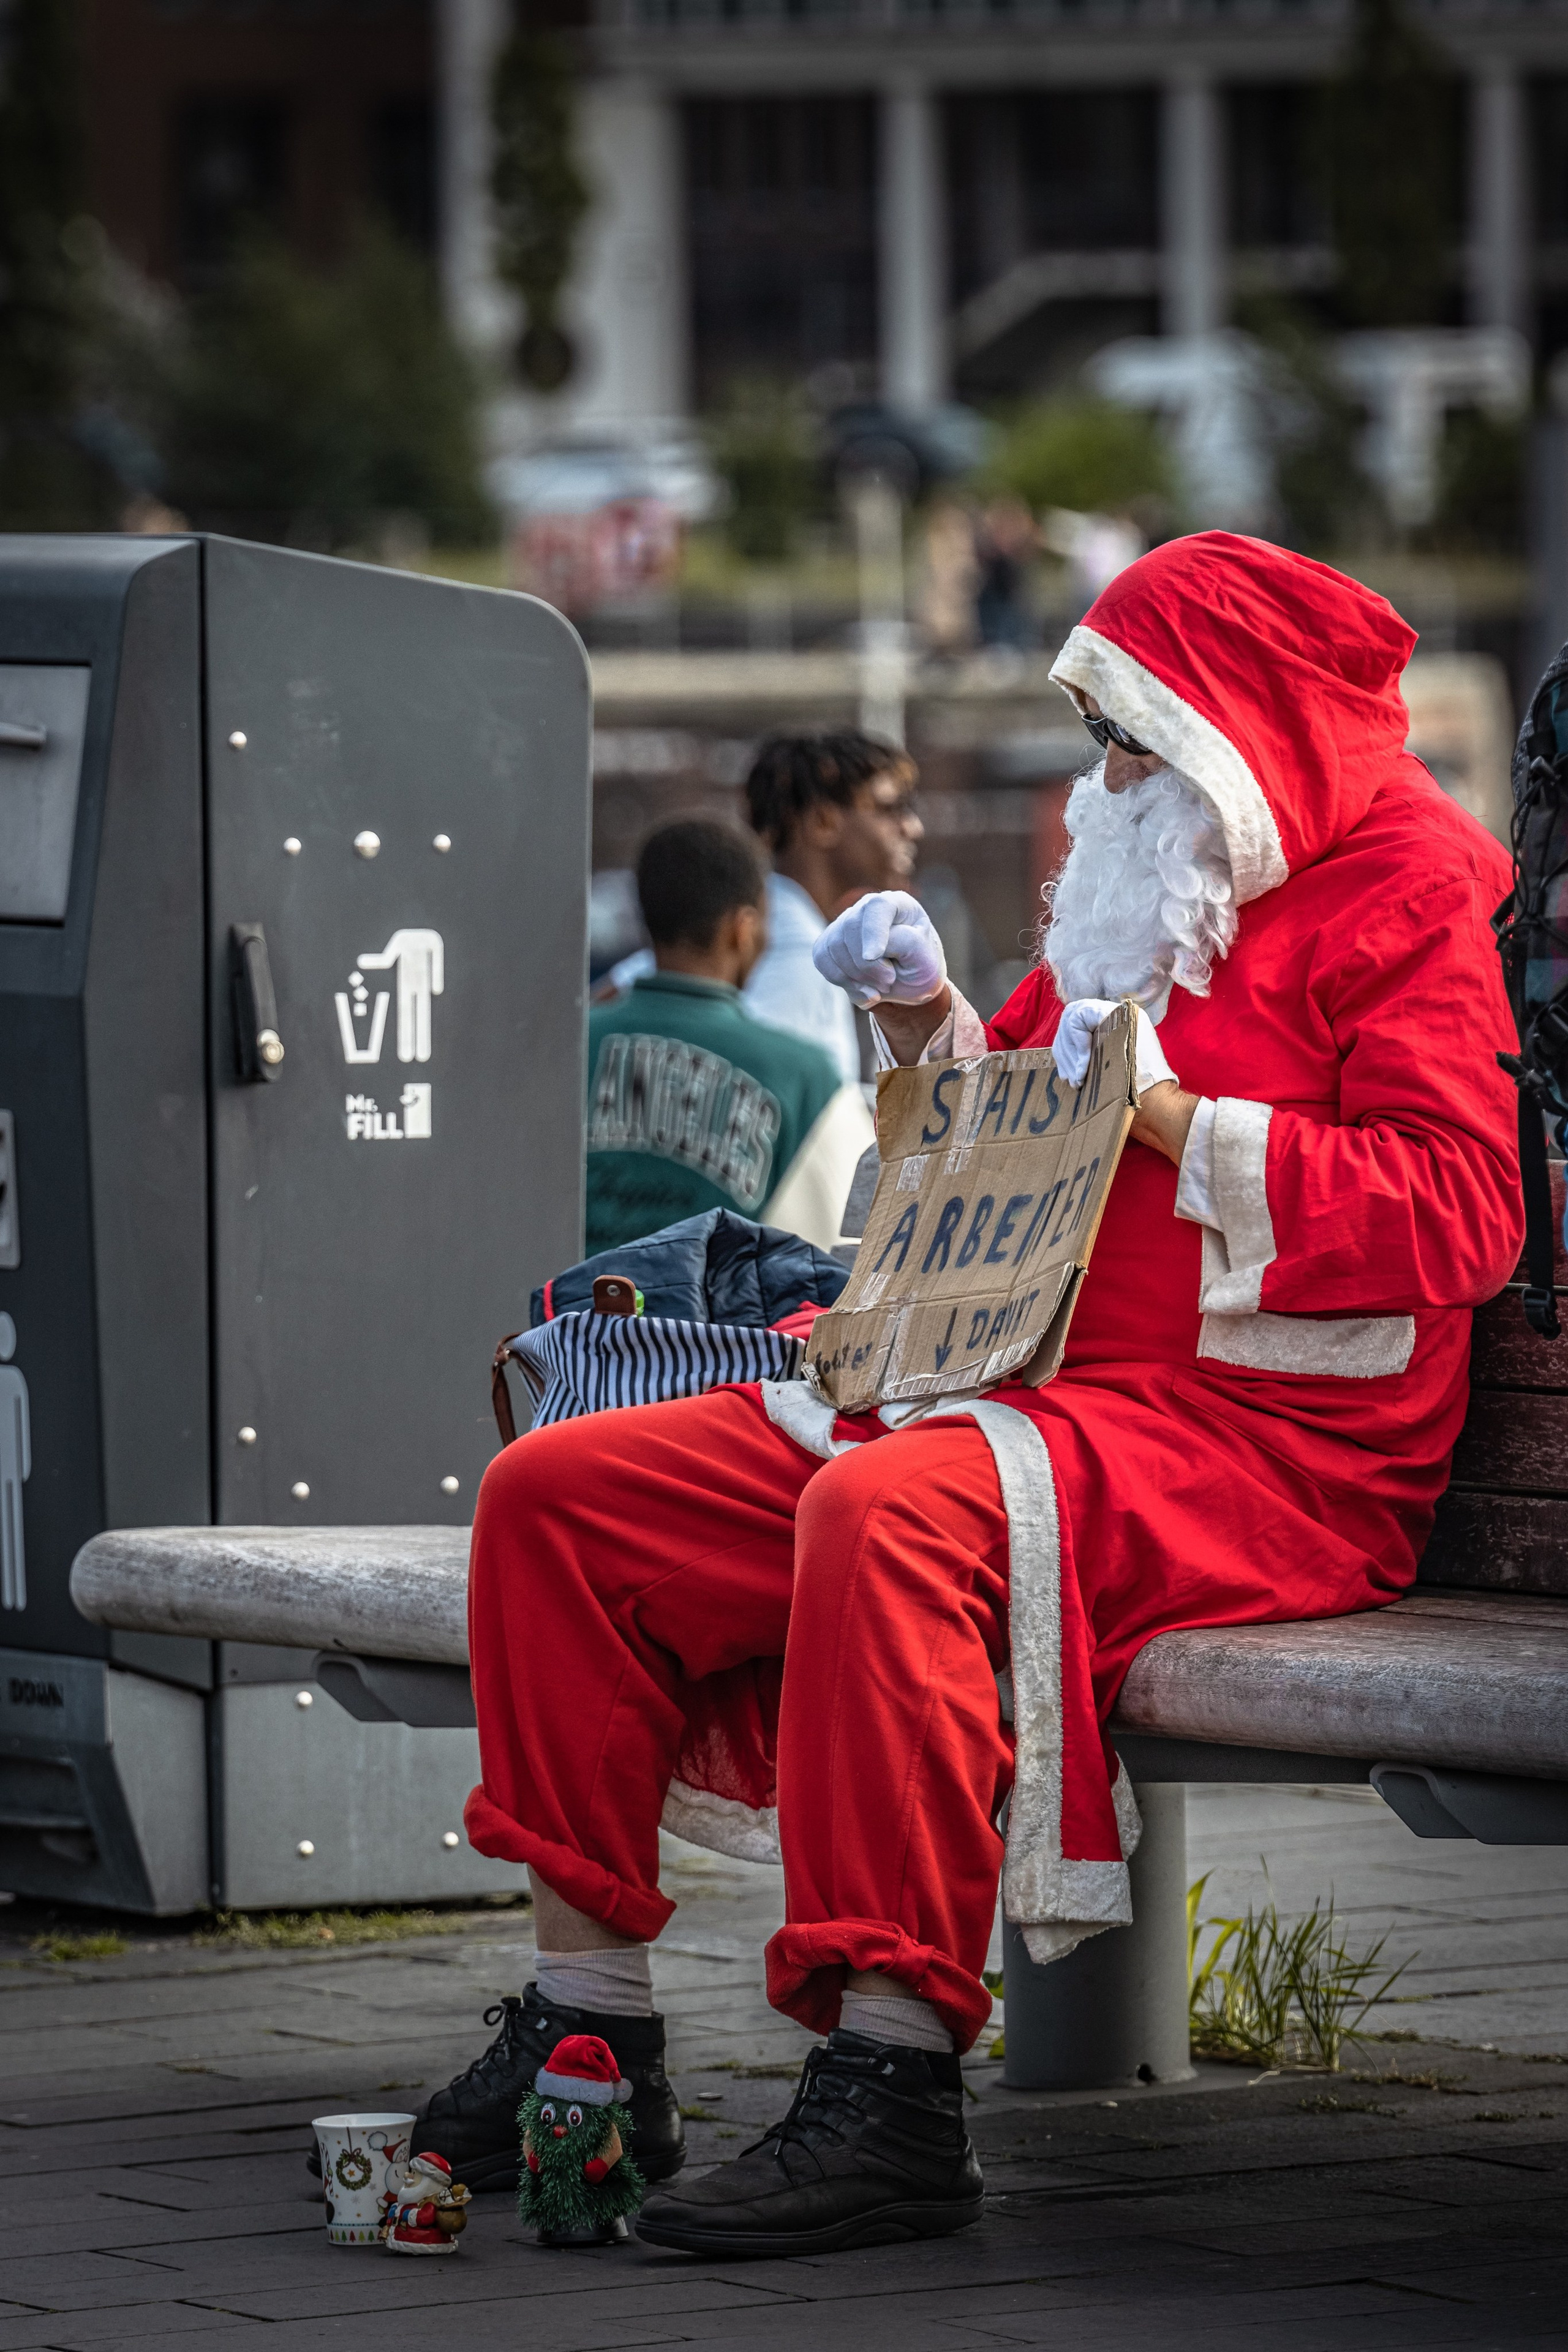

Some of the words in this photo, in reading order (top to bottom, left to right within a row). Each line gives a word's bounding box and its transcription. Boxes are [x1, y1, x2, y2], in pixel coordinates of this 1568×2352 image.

[345, 1094, 378, 1113] Mr.
[347, 1112, 404, 1140] FILL
[872, 1156, 1100, 1273] ARBEITER
[9, 1677, 64, 1708] DOWN
